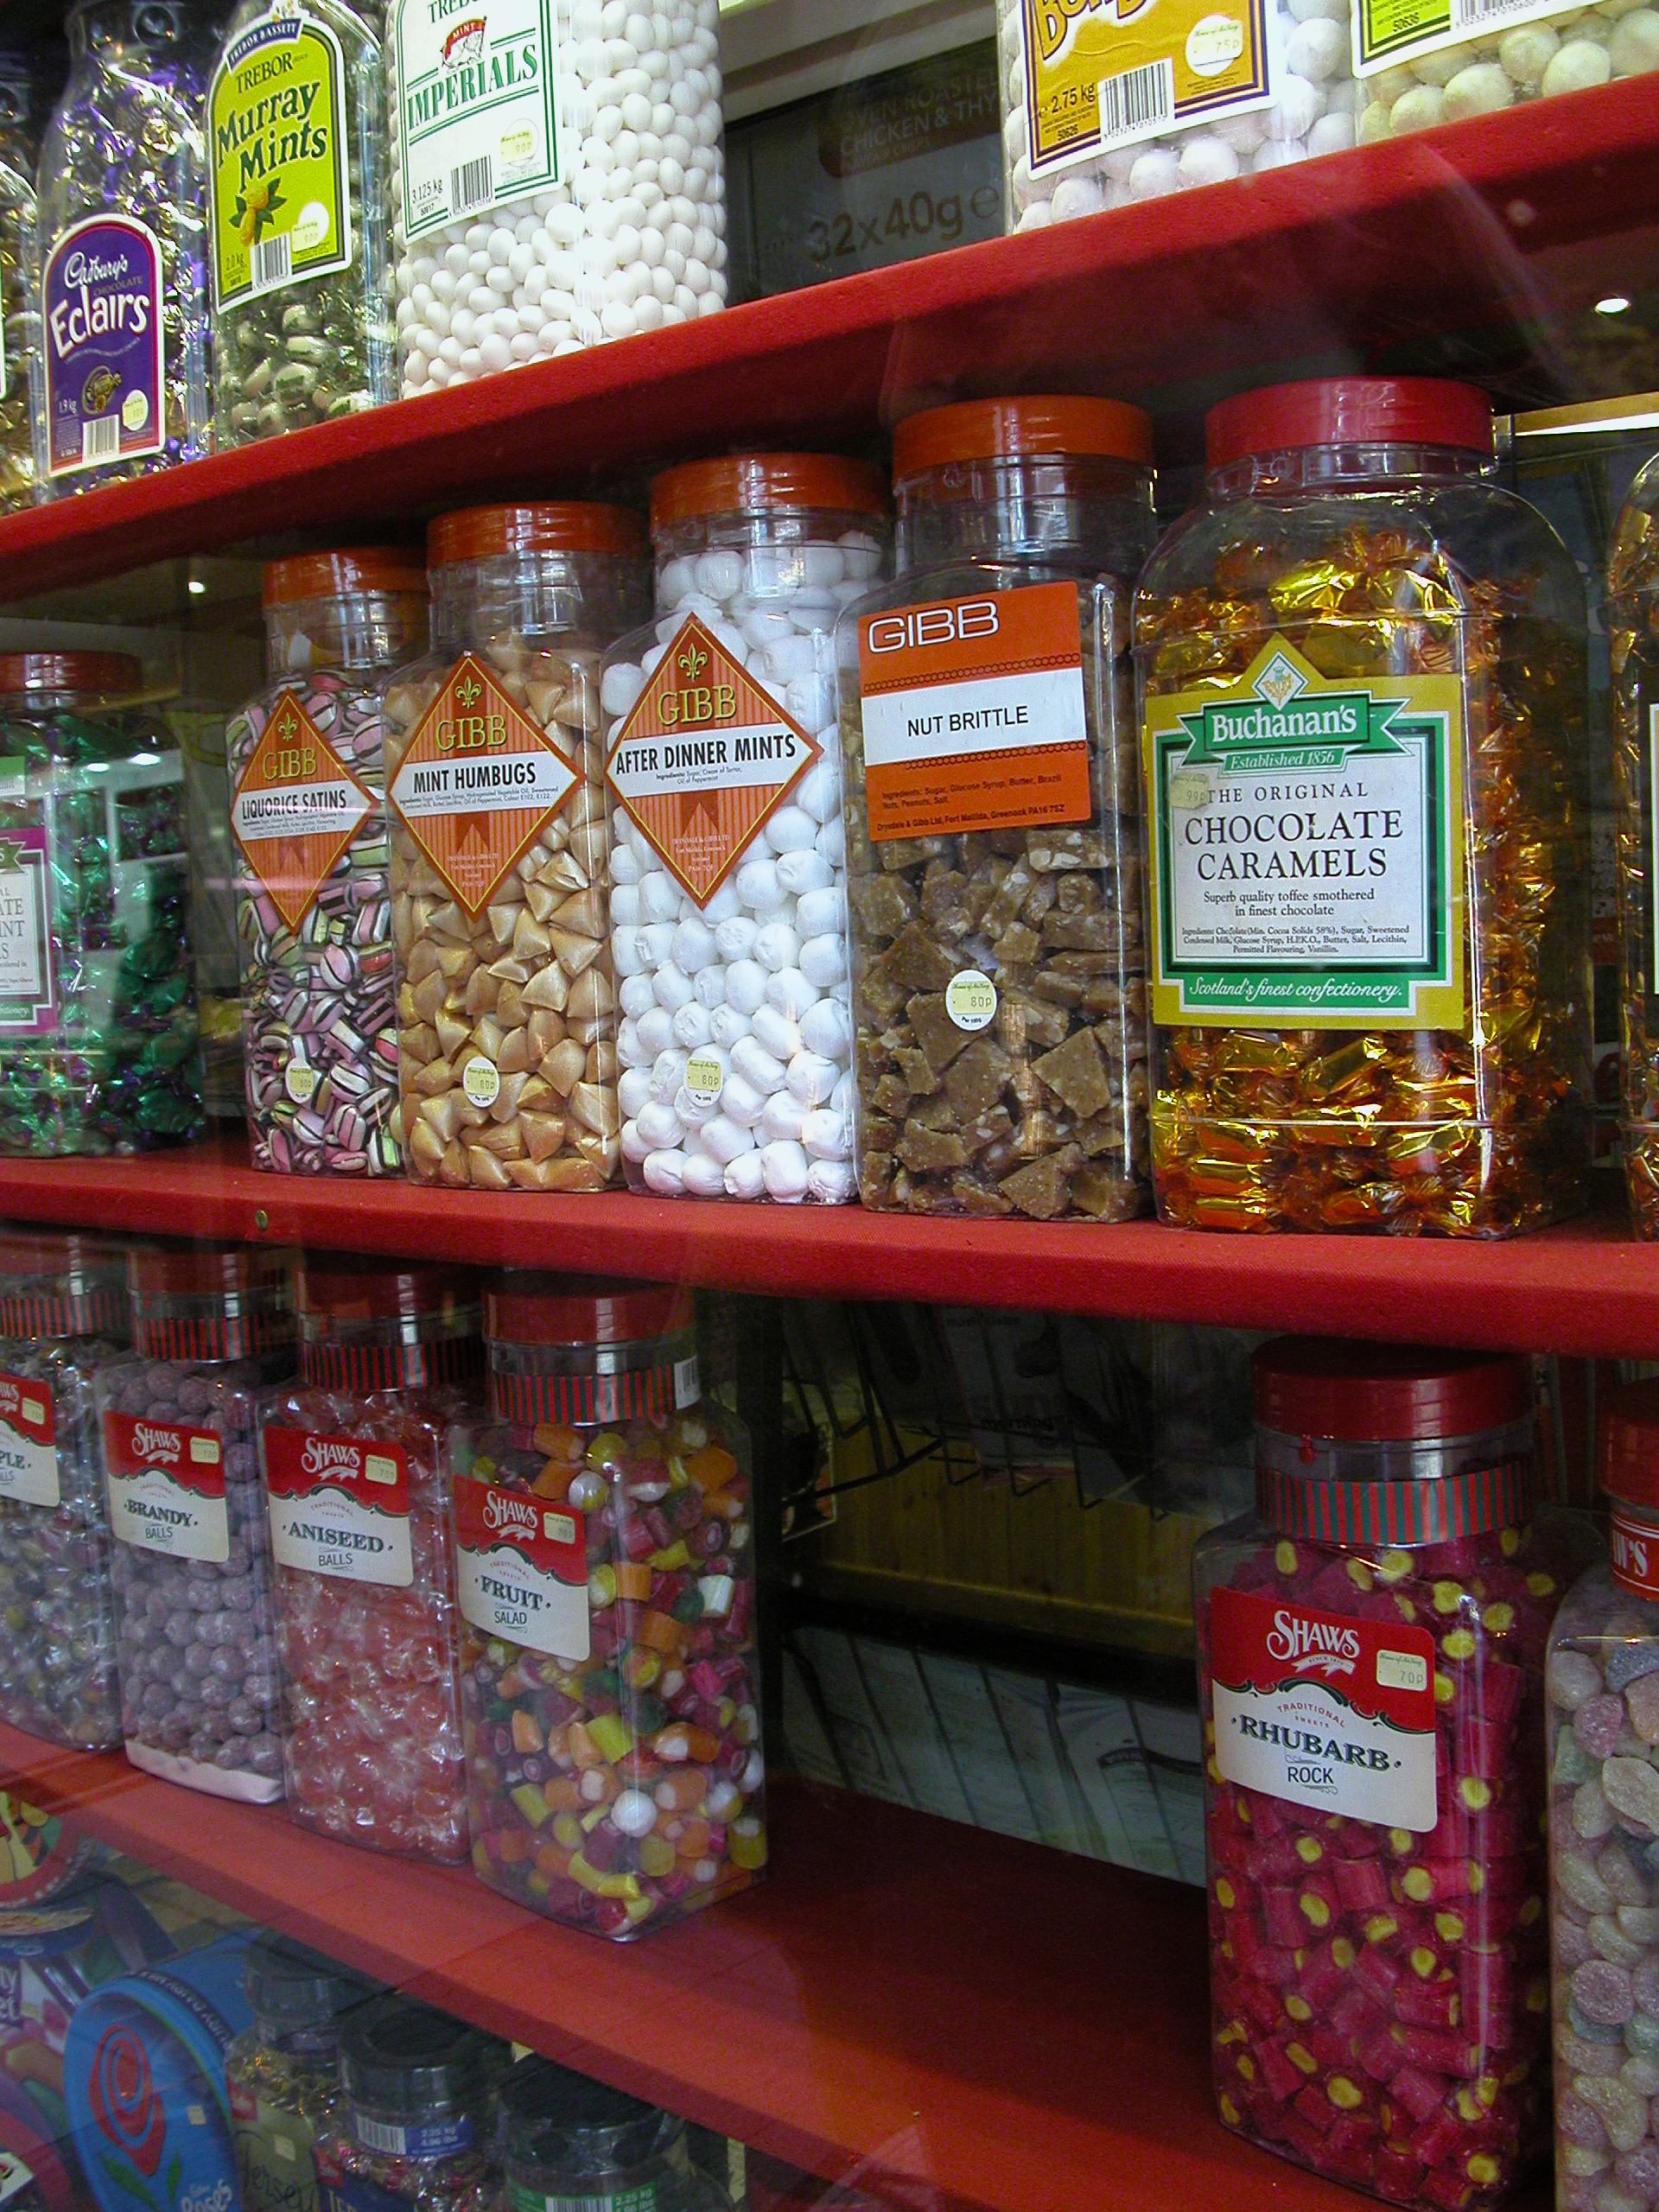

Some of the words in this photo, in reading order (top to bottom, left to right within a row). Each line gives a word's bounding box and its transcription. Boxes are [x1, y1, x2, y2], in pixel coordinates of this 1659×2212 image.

[452, 22, 476, 40] MINT
[236, 51, 294, 94] TREBOR
[407, 43, 538, 130] IMPERIALS
[1051, 86, 1078, 113] 2.75
[1081, 82, 1096, 103] kg
[217, 79, 321, 169] Murray
[840, 114, 931, 156] CHICKEN
[934, 109, 950, 128] &
[238, 125, 328, 193] Mints
[411, 181, 432, 204] 3.125
[432, 179, 442, 195] kg
[63, 251, 129, 293] Cadbury's
[92, 274, 143, 296] CHOCOLATE
[50, 286, 150, 359] Eclairs
[868, 599, 1001, 655] GIBB
[656, 683, 737, 727] GIBB
[435, 714, 508, 752] GIBB
[907, 715, 944, 737] NUT
[950, 706, 1029, 732] BRITTLE
[1211, 703, 1357, 743] Buchanan's
[262, 747, 318, 782] GIBB
[616, 747, 658, 775] AFTER
[664, 740, 728, 767] DINNER
[734, 734, 797, 762] MINTS
[1230, 753, 1306, 771] Established
[1306, 750, 1336, 766] 1856
[413, 769, 449, 794] MINT
[454, 761, 537, 790] HUMBUGS
[1038, 774, 1062, 784] Brazil
[1207, 788, 1243, 804] THE
[1255, 781, 1370, 802] ORIGINAL
[241, 794, 299, 821] LIQUORICE
[302, 789, 347, 814] SATINS
[1185, 809, 1404, 846] CHOCOLATE
[1197, 848, 1388, 880] CARAMELS
[1204, 891, 1236, 906] Superb
[1239, 890, 1276, 905] quality
[1277, 889, 1309, 901] toffee
[1313, 887, 1375, 900] smothered
[1235, 906, 1247, 916] in
[1249, 904, 1278, 916] finest
[1281, 904, 1335, 916] chocolate
[1268, 926, 1290, 935] Cocoa
[1367, 925, 1410, 934] Sweetened
[1189, 976, 1254, 1003] Scotland's
[1252, 978, 1294, 1001] finest
[1295, 977, 1403, 1003] confectionery.
[126, 1499, 193, 1528] BRANDY
[145, 1526, 174, 1540] BALLS
[288, 1521, 385, 1554] ANISEED
[318, 1554, 353, 1567] BALLS
[480, 1574, 544, 1612] FRUIT
[493, 1610, 528, 1626] SALAD
[1276, 1700, 1345, 1729] TRADITIONAL
[1239, 1713, 1391, 1772] RHUBARB
[1287, 1765, 1335, 1784] ROCK
